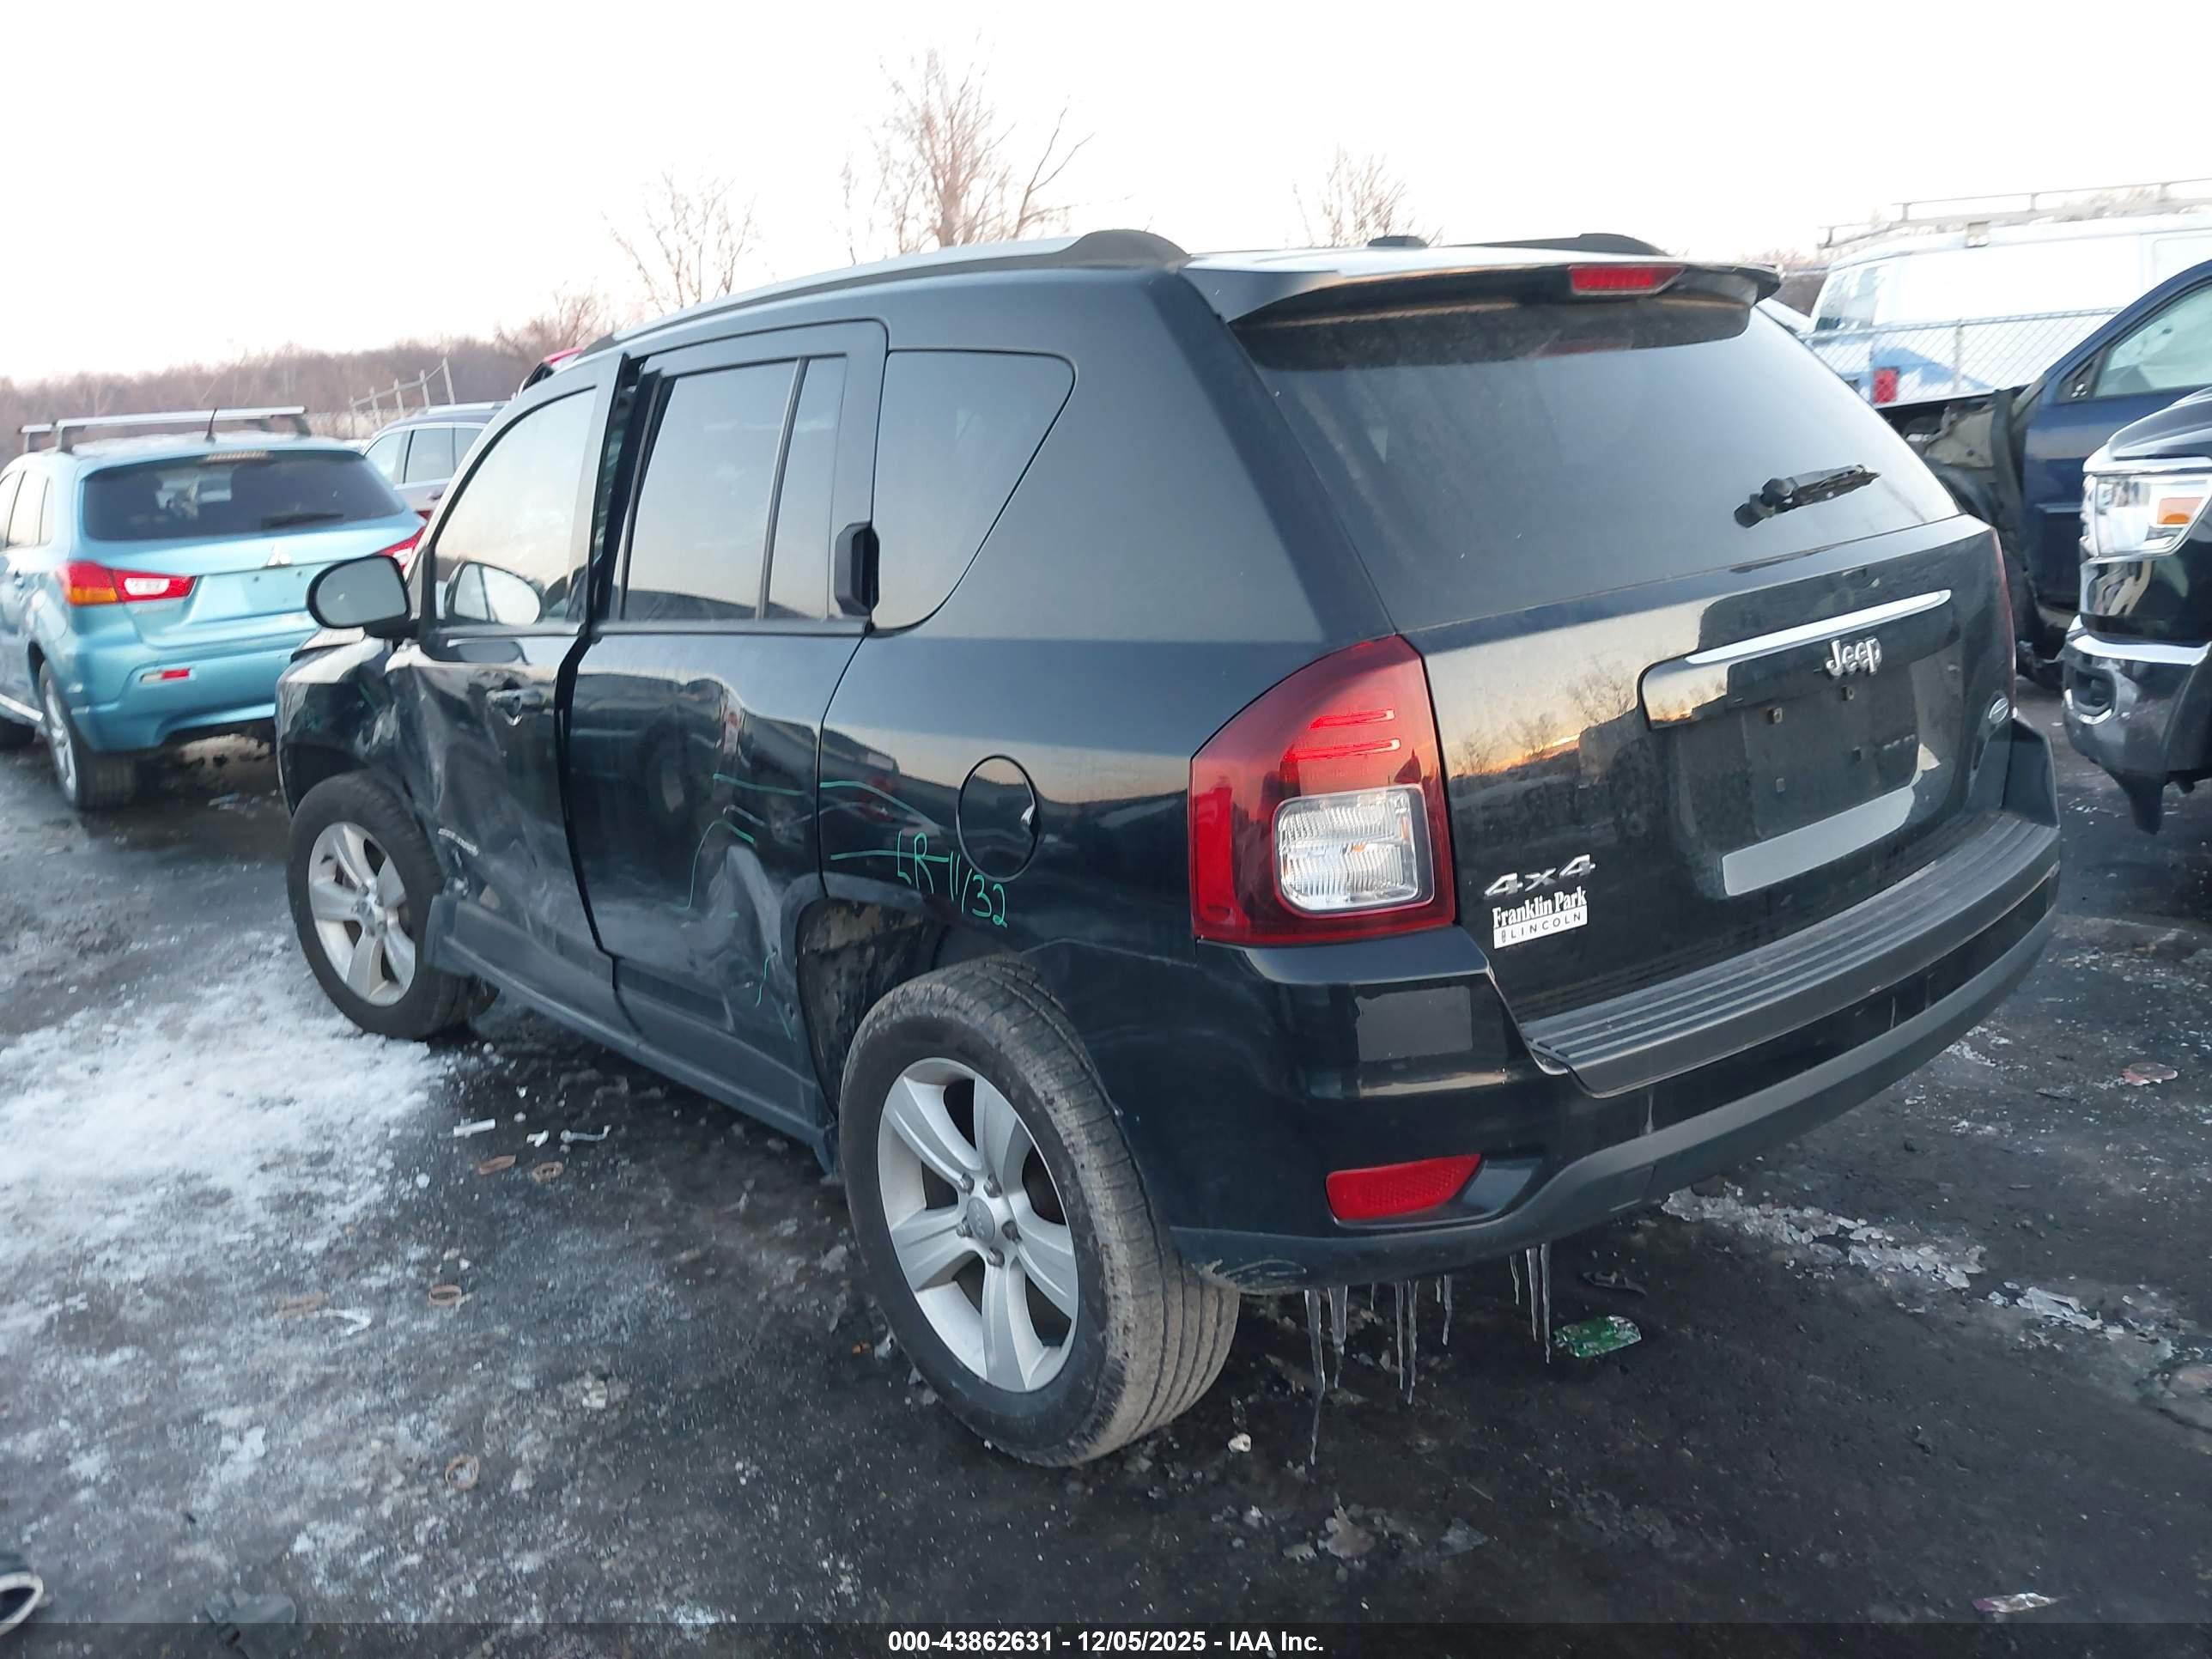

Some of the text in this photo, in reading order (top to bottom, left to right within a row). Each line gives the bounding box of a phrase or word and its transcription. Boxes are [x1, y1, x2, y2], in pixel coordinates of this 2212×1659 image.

[1825, 636, 1883, 678] Jeep
[1492, 885, 1587, 929] Franklin Park
[1510, 910, 1582, 939] LINCOLN
